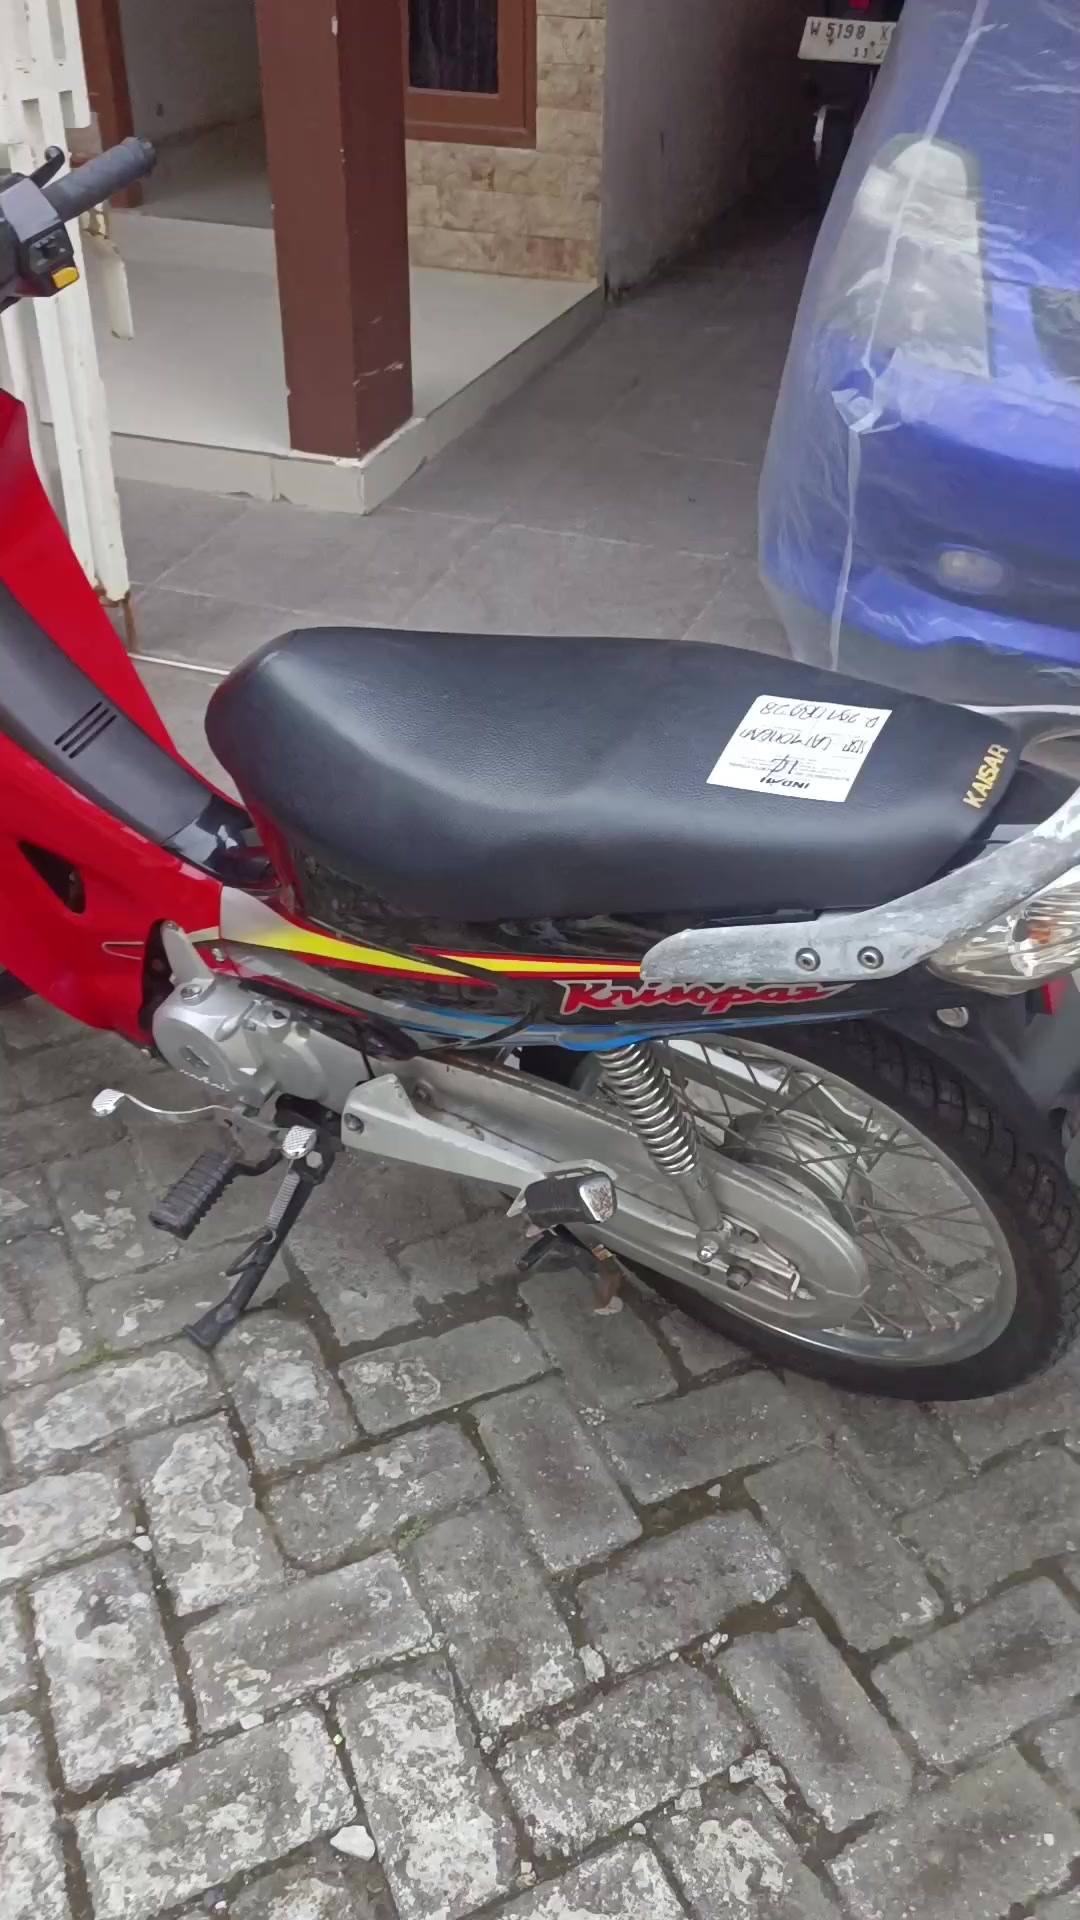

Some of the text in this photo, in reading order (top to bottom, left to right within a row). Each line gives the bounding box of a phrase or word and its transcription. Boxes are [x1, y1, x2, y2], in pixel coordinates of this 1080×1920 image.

[809, 21, 821, 36] W
[826, 22, 866, 40] 5198
[962, 743, 1010, 809] KAISAR
